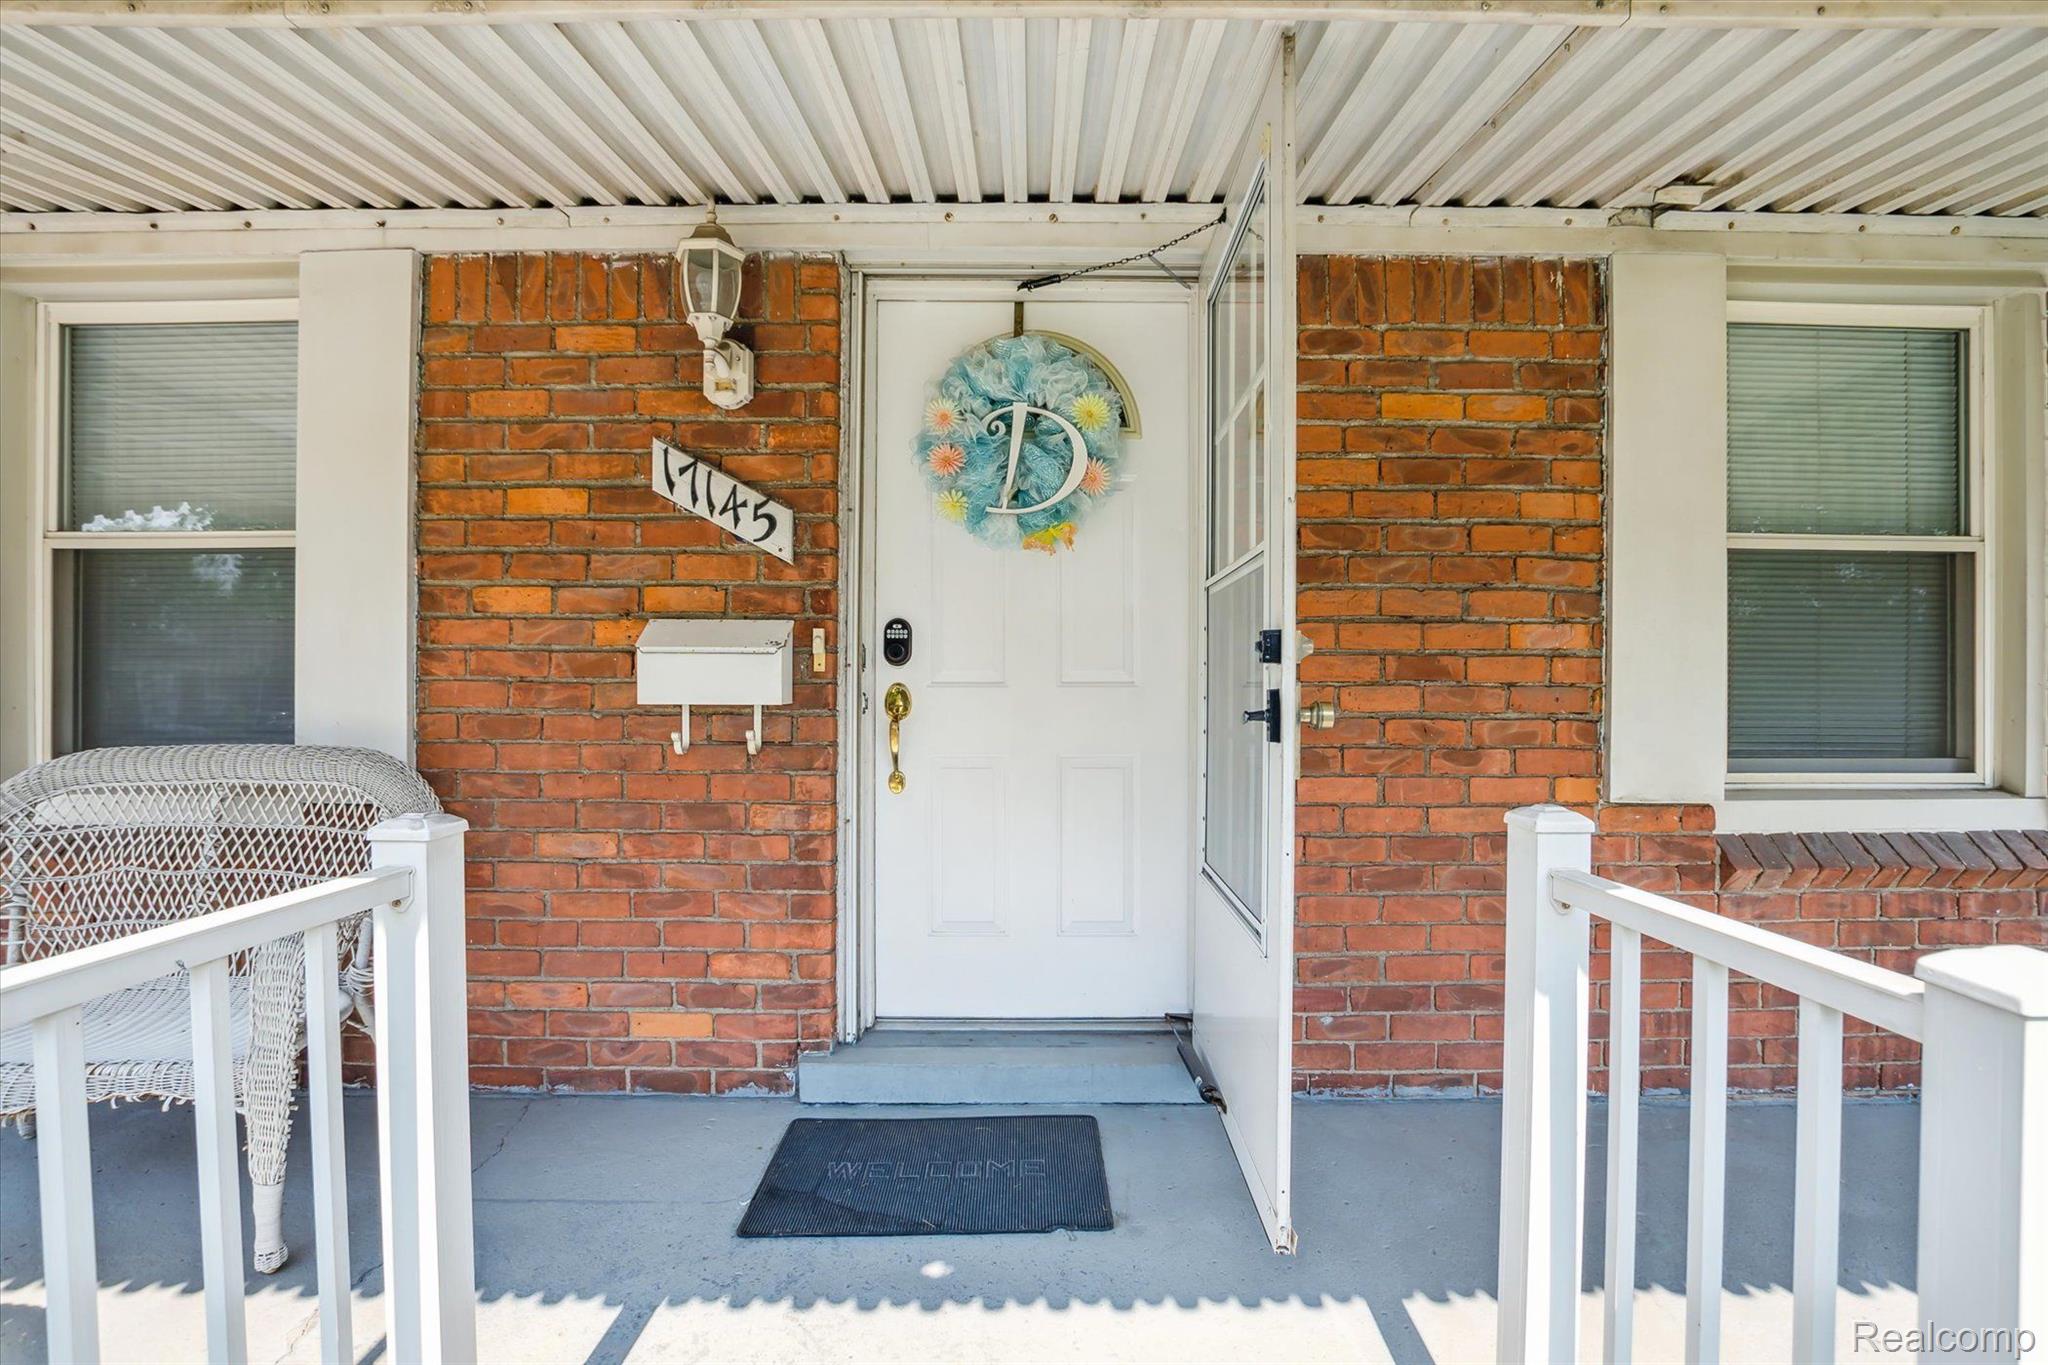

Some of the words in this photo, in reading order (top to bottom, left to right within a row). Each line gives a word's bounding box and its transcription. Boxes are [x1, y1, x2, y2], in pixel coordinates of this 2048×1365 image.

[662, 446, 778, 542] 17145
[981, 402, 1088, 513] D
[827, 1159, 1046, 1181] WELCOME
